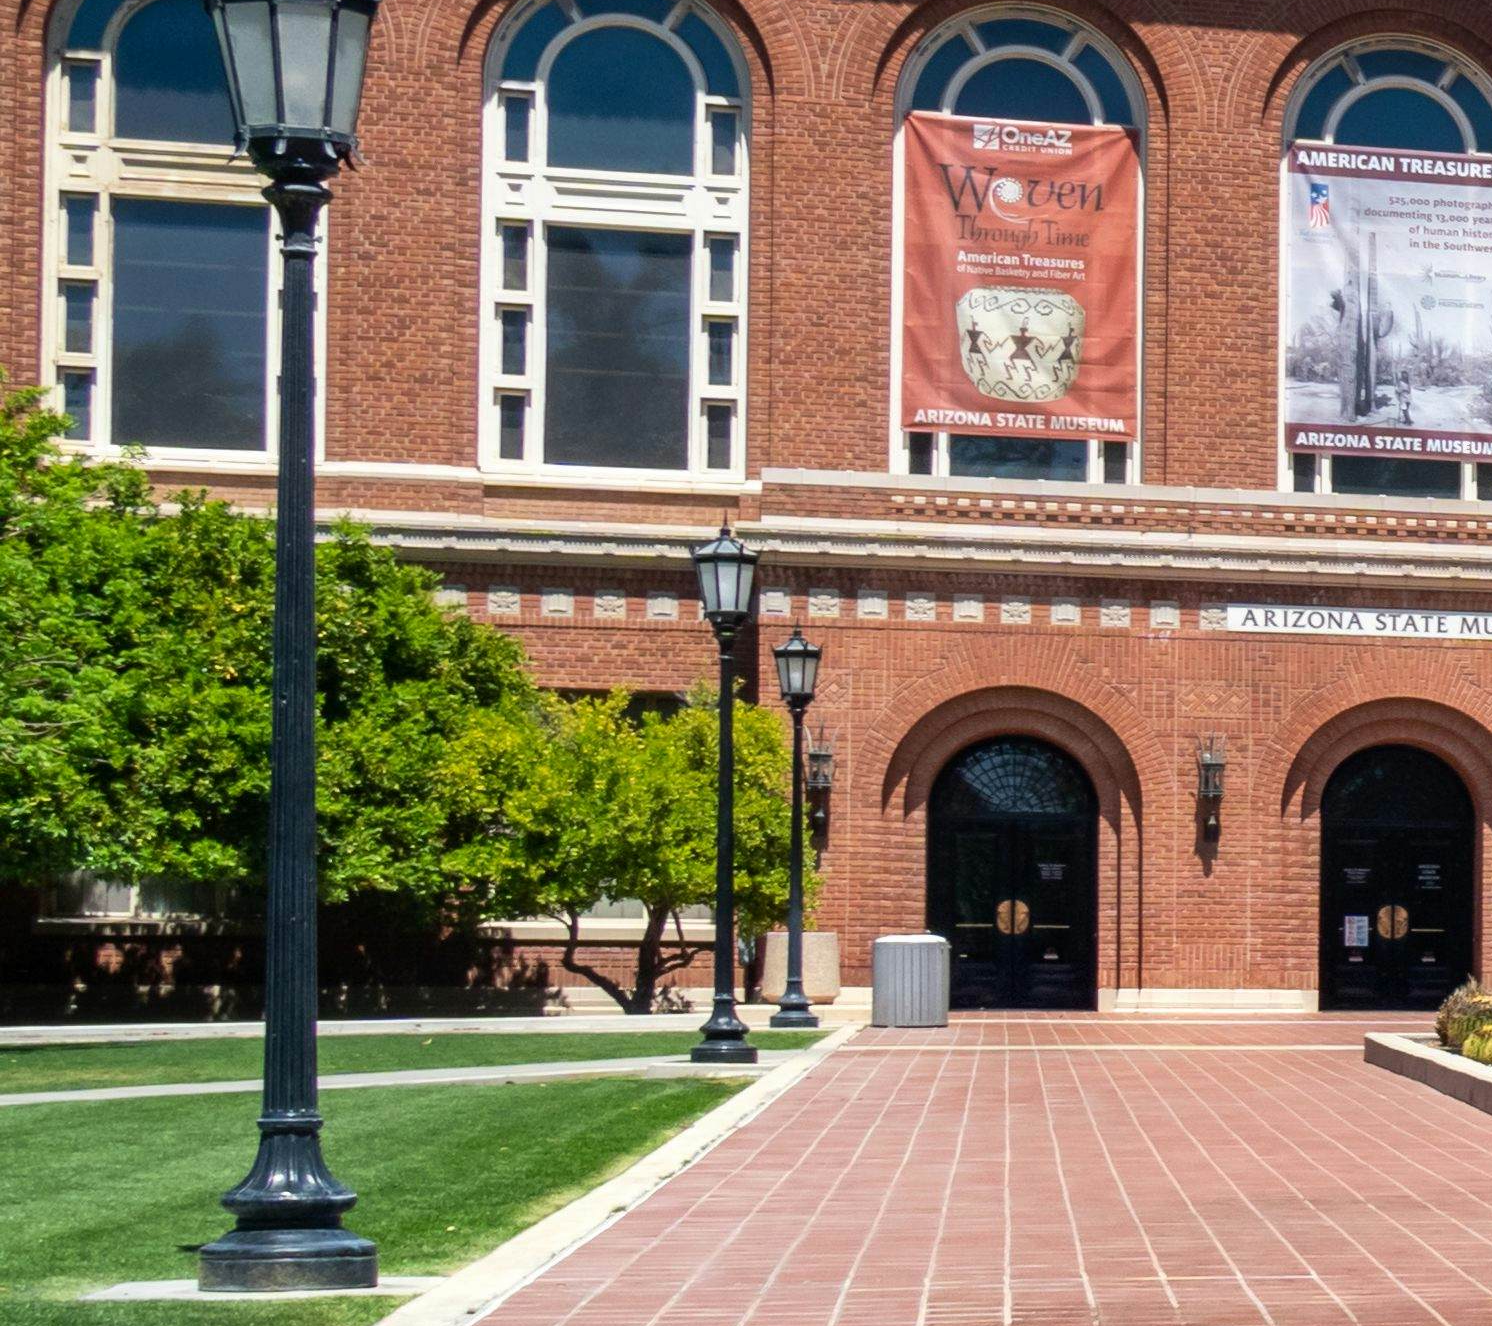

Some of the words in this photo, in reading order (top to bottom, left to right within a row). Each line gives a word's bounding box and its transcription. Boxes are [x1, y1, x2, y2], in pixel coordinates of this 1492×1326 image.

[1001, 126, 1072, 148] OneAZ
[1297, 150, 1395, 173] AMERICAN
[1364, 208, 1433, 222] documenting
[954, 215, 1039, 251] Through
[1042, 222, 1090, 248] Time
[1408, 225, 1421, 234] of
[1423, 226, 1459, 237] human
[1409, 239, 1420, 248] in
[1423, 240, 1441, 250] the
[958, 250, 1020, 266] American
[1022, 253, 1085, 270] Treasures
[1072, 271, 1086, 281] Art
[914, 409, 992, 427] ARIZONA
[996, 413, 1046, 430] STATE
[1050, 416, 1125, 433] MUSEUM
[1295, 431, 1371, 449] ARIZONA
[1374, 435, 1422, 452] STATE
[1241, 609, 1364, 631] ARIZONA
[1375, 613, 1449, 634] STATE
